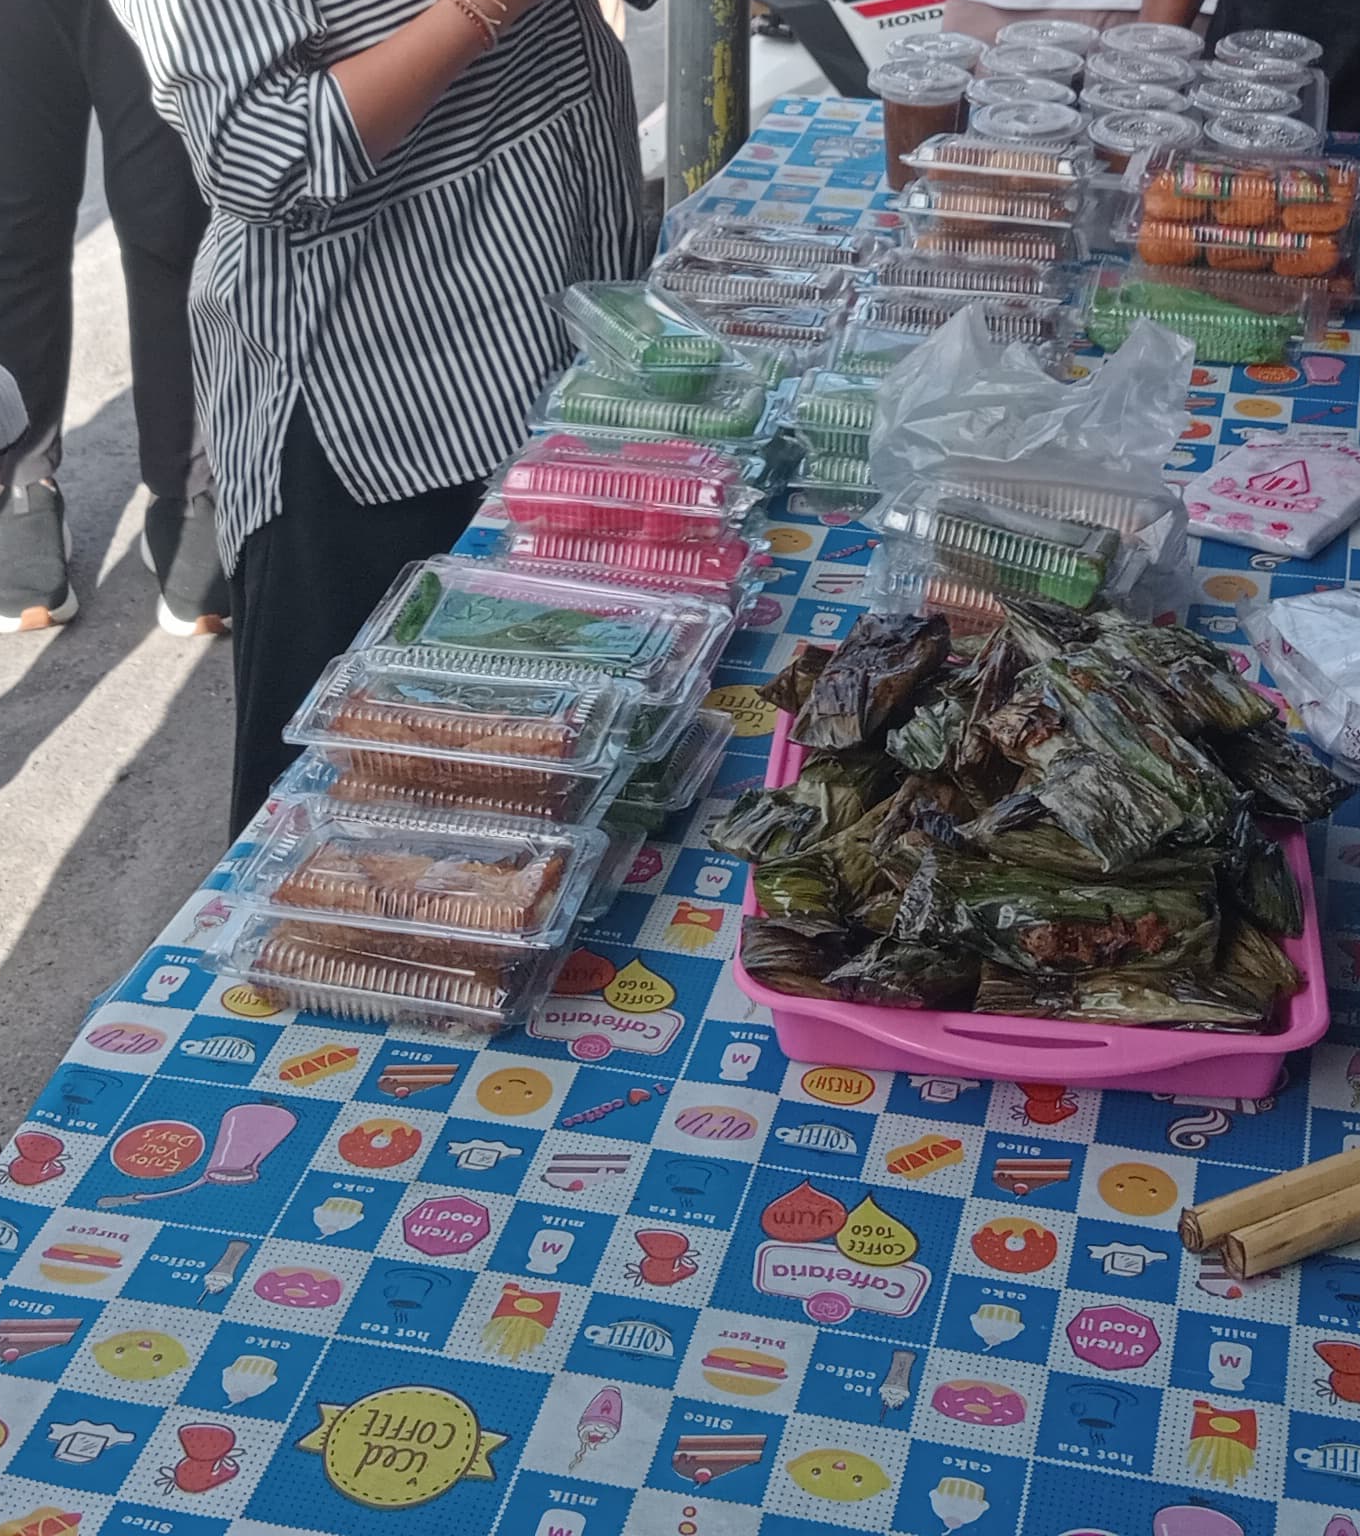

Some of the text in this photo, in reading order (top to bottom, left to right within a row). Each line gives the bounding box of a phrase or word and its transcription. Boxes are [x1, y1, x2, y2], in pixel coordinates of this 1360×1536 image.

[878, 8, 944, 30] HOND
[732, 710, 764, 730] ice
[614, 991, 666, 1005] COFFEE
[544, 1010, 663, 1041] Caffetaria
[730, 1030, 771, 1041] milk
[391, 1048, 433, 1063] Slice
[808, 1073, 864, 1095] FRESH!
[560, 1097, 625, 1129] coffee
[67, 1117, 98, 1132] hot
[142, 1127, 197, 1149] Day's
[996, 1141, 1041, 1157] Slice
[125, 1152, 182, 1173] Enjoy
[331, 1181, 376, 1195] cake
[541, 1214, 586, 1228] milk
[648, 1205, 716, 1224] hot tea
[771, 1208, 835, 1230] yum
[65, 1224, 131, 1244] burger
[411, 1223, 475, 1246] d'fresh
[846, 1238, 906, 1257] COFFEE
[149, 1252, 206, 1268] coffee
[171, 1270, 198, 1285] ice
[771, 1262, 907, 1299] Caffetaria
[980, 1286, 1028, 1301] cake
[8, 1297, 56, 1316] Slice
[1319, 1313, 1351, 1327] tea
[360, 1321, 430, 1342] hot tea
[609, 1324, 667, 1353] COFFEE
[718, 1326, 787, 1351] burger
[1209, 1325, 1259, 1339] milk
[244, 1335, 292, 1351] cake
[1075, 1334, 1145, 1356] d'fresh
[814, 1362, 878, 1381] coffee
[843, 1381, 873, 1397] ice
[358, 1407, 457, 1451] COFFEE
[682, 1410, 735, 1431] Slice
[1057, 1441, 1134, 1466] hot tea
[354, 1441, 429, 1487] iced
[942, 1455, 992, 1473] cake
[548, 1488, 599, 1507] milk
[120, 1514, 174, 1535] Slice
